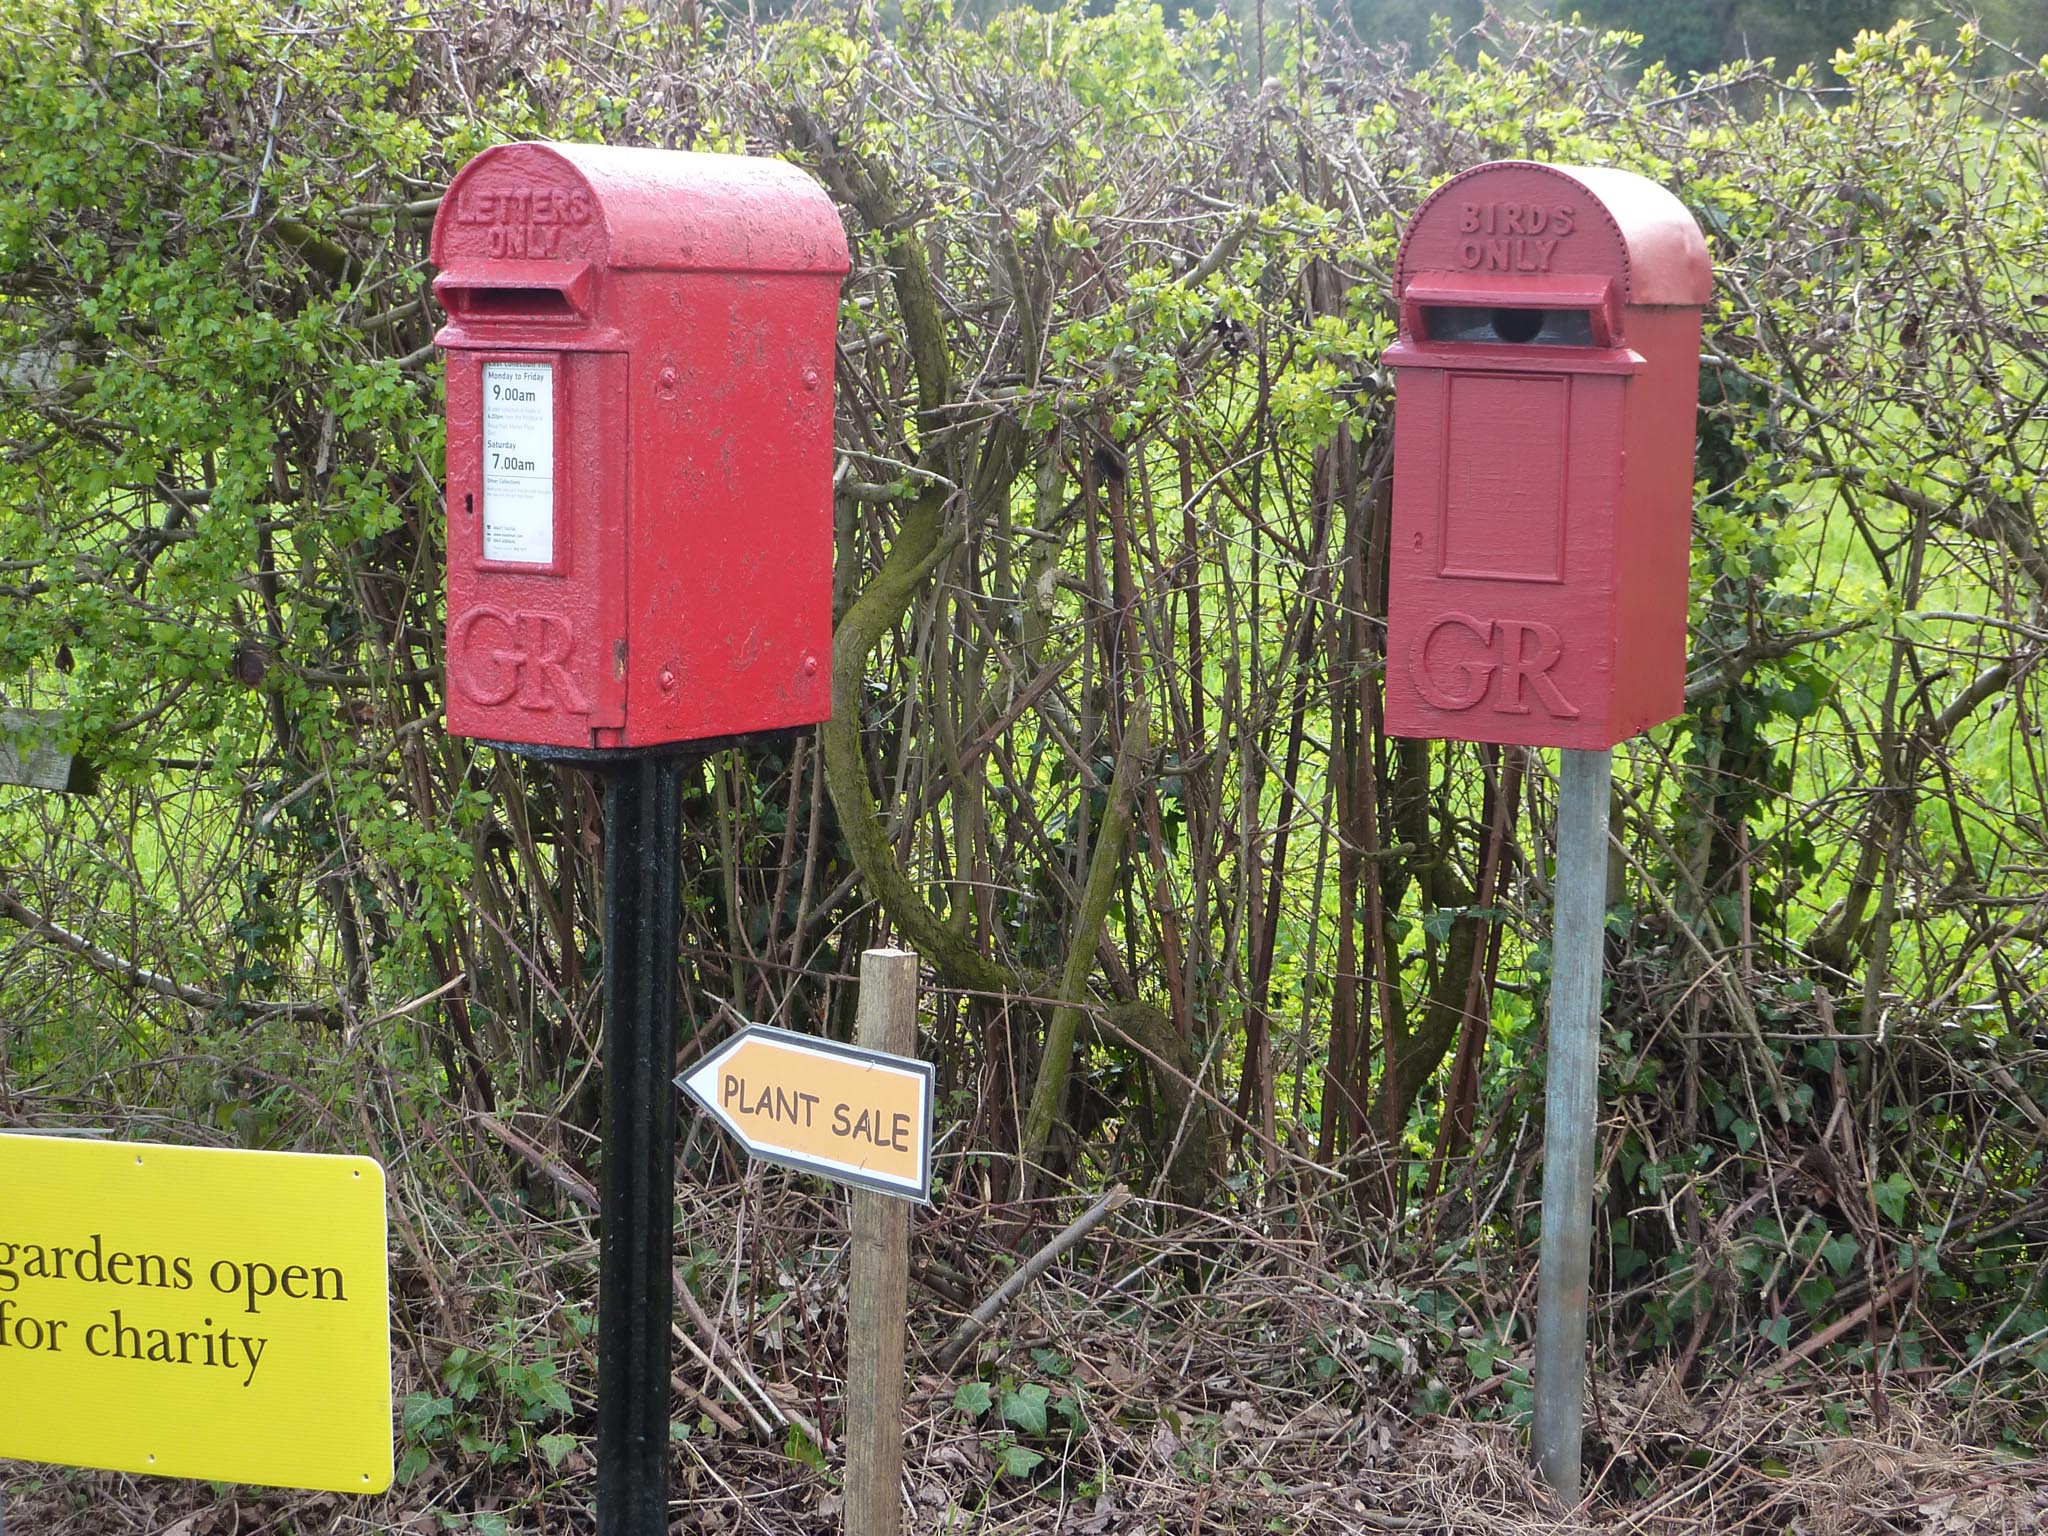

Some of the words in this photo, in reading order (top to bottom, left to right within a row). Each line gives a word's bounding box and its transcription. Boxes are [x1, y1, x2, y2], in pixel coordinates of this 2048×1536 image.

[458, 187, 592, 226] LETTERS
[1460, 201, 1576, 237] BIRDS
[487, 225, 562, 260] ONLY
[1460, 238, 1559, 273] ONLY
[488, 371, 513, 380] Monday
[523, 372, 544, 382] Friday
[493, 384, 536, 402] 9.00am
[487, 440, 517, 450] Saturday
[492, 453, 535, 471] 7.00am
[450, 604, 592, 716] GR
[1408, 610, 1581, 720] GR
[723, 1074, 820, 1127] PLANT
[831, 1103, 911, 1152] SALE
[0, 1233, 194, 1291] gardens
[209, 1258, 348, 1314] open
[0, 1299, 68, 1351] for
[85, 1309, 268, 1387] charity
